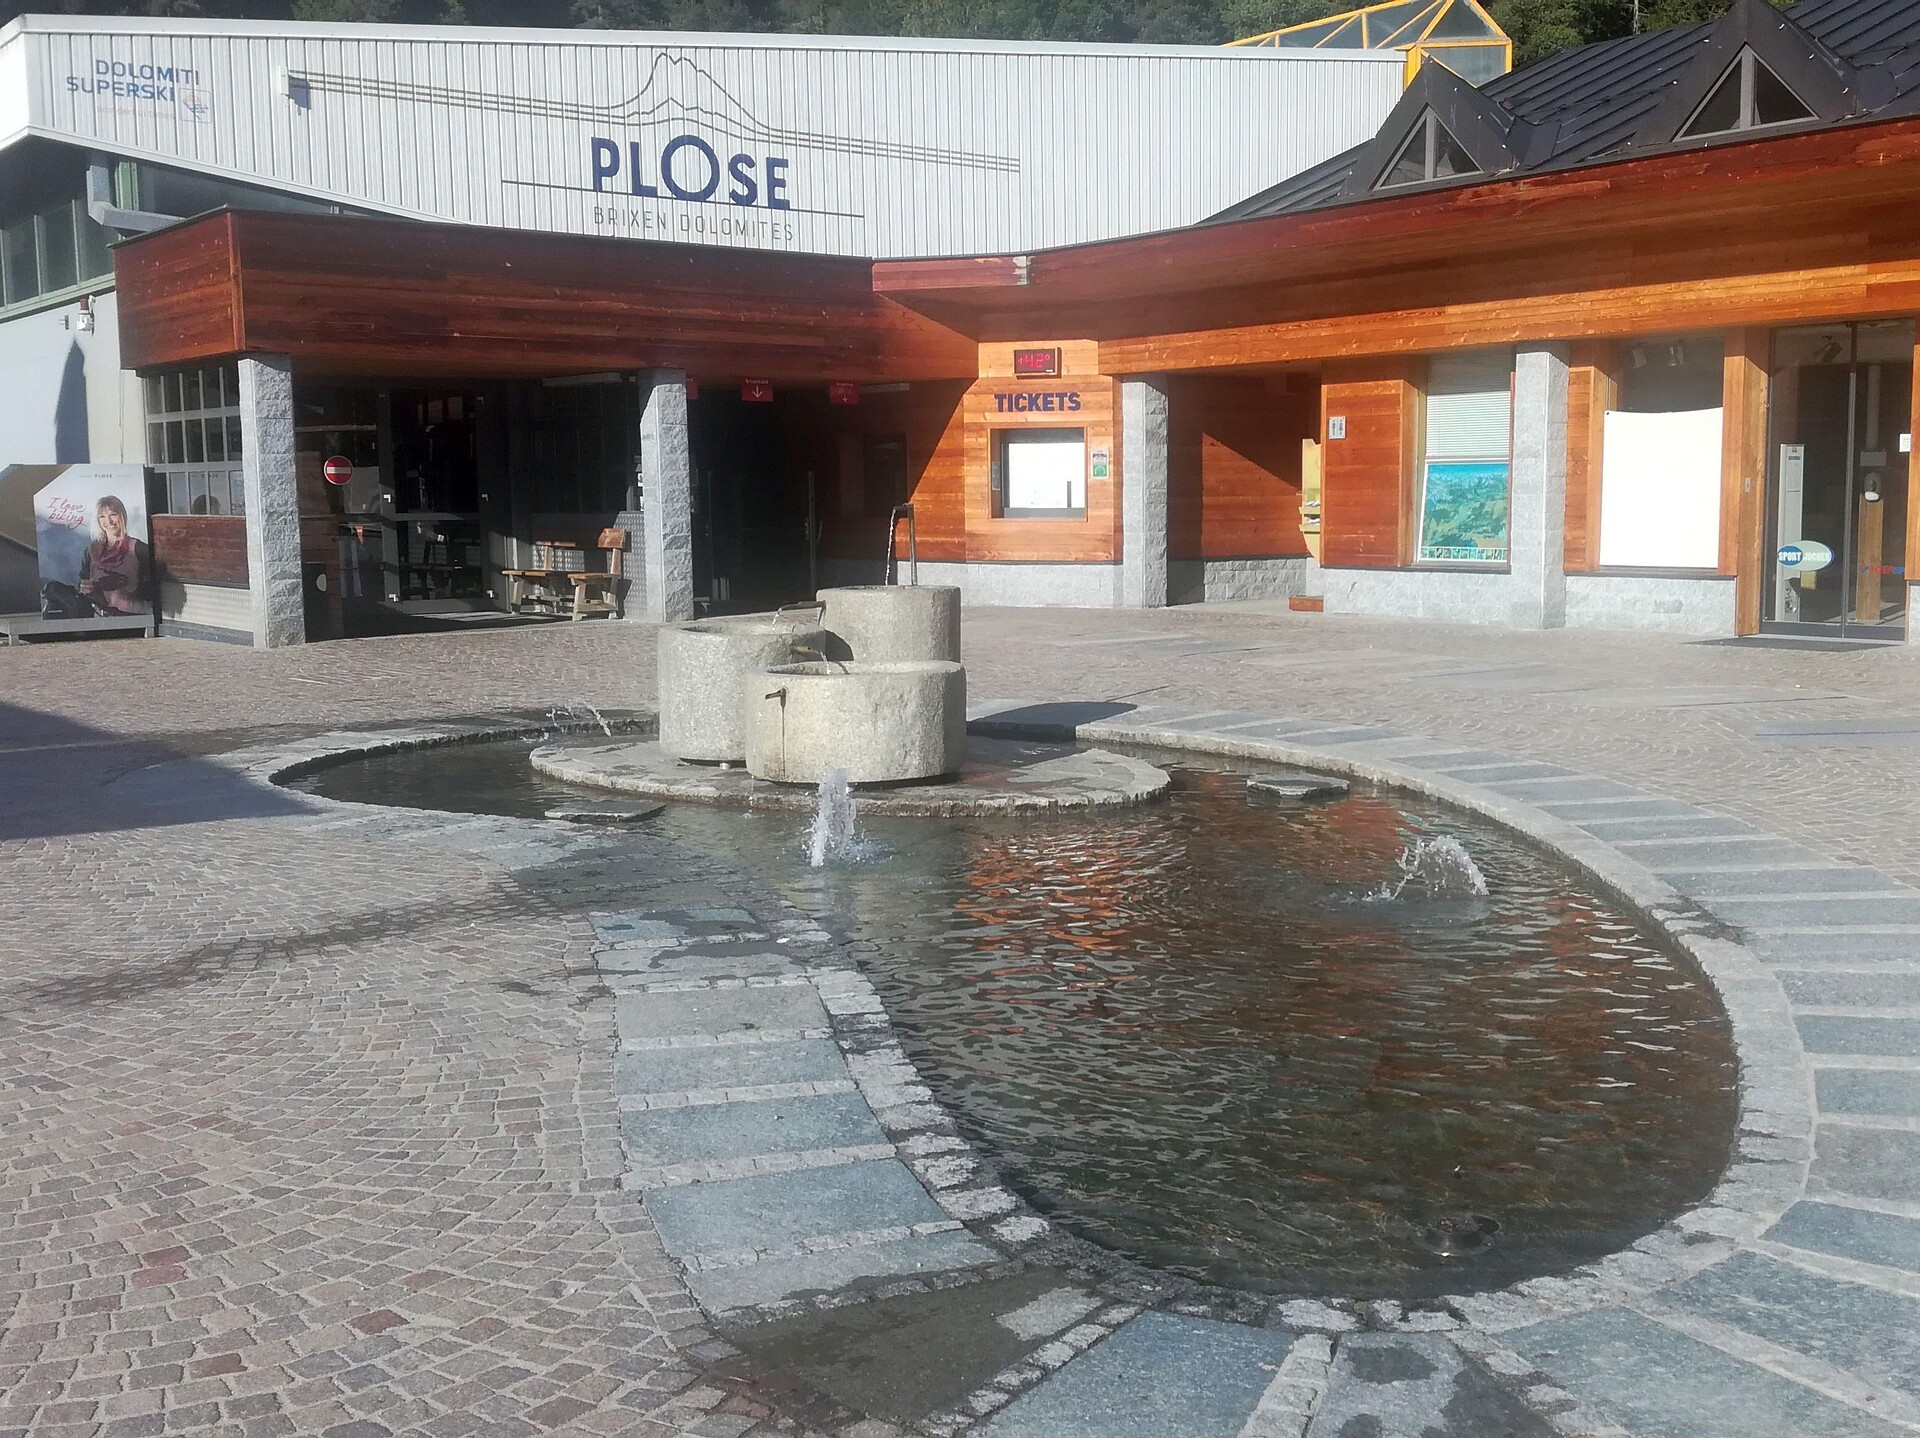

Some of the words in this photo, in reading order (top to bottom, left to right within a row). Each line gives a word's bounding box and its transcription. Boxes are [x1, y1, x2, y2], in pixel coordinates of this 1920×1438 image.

[95, 59, 199, 86] DOLOMITI
[66, 76, 176, 102] SUPERSKI
[590, 134, 791, 211] PLOSE
[594, 206, 667, 230] BRIXEN
[679, 215, 794, 241] DOLOMITES
[993, 392, 1082, 413] TICKETS
[60, 498, 87, 513] love
[48, 508, 88, 531] biking
[1777, 551, 1802, 562] SPORT
